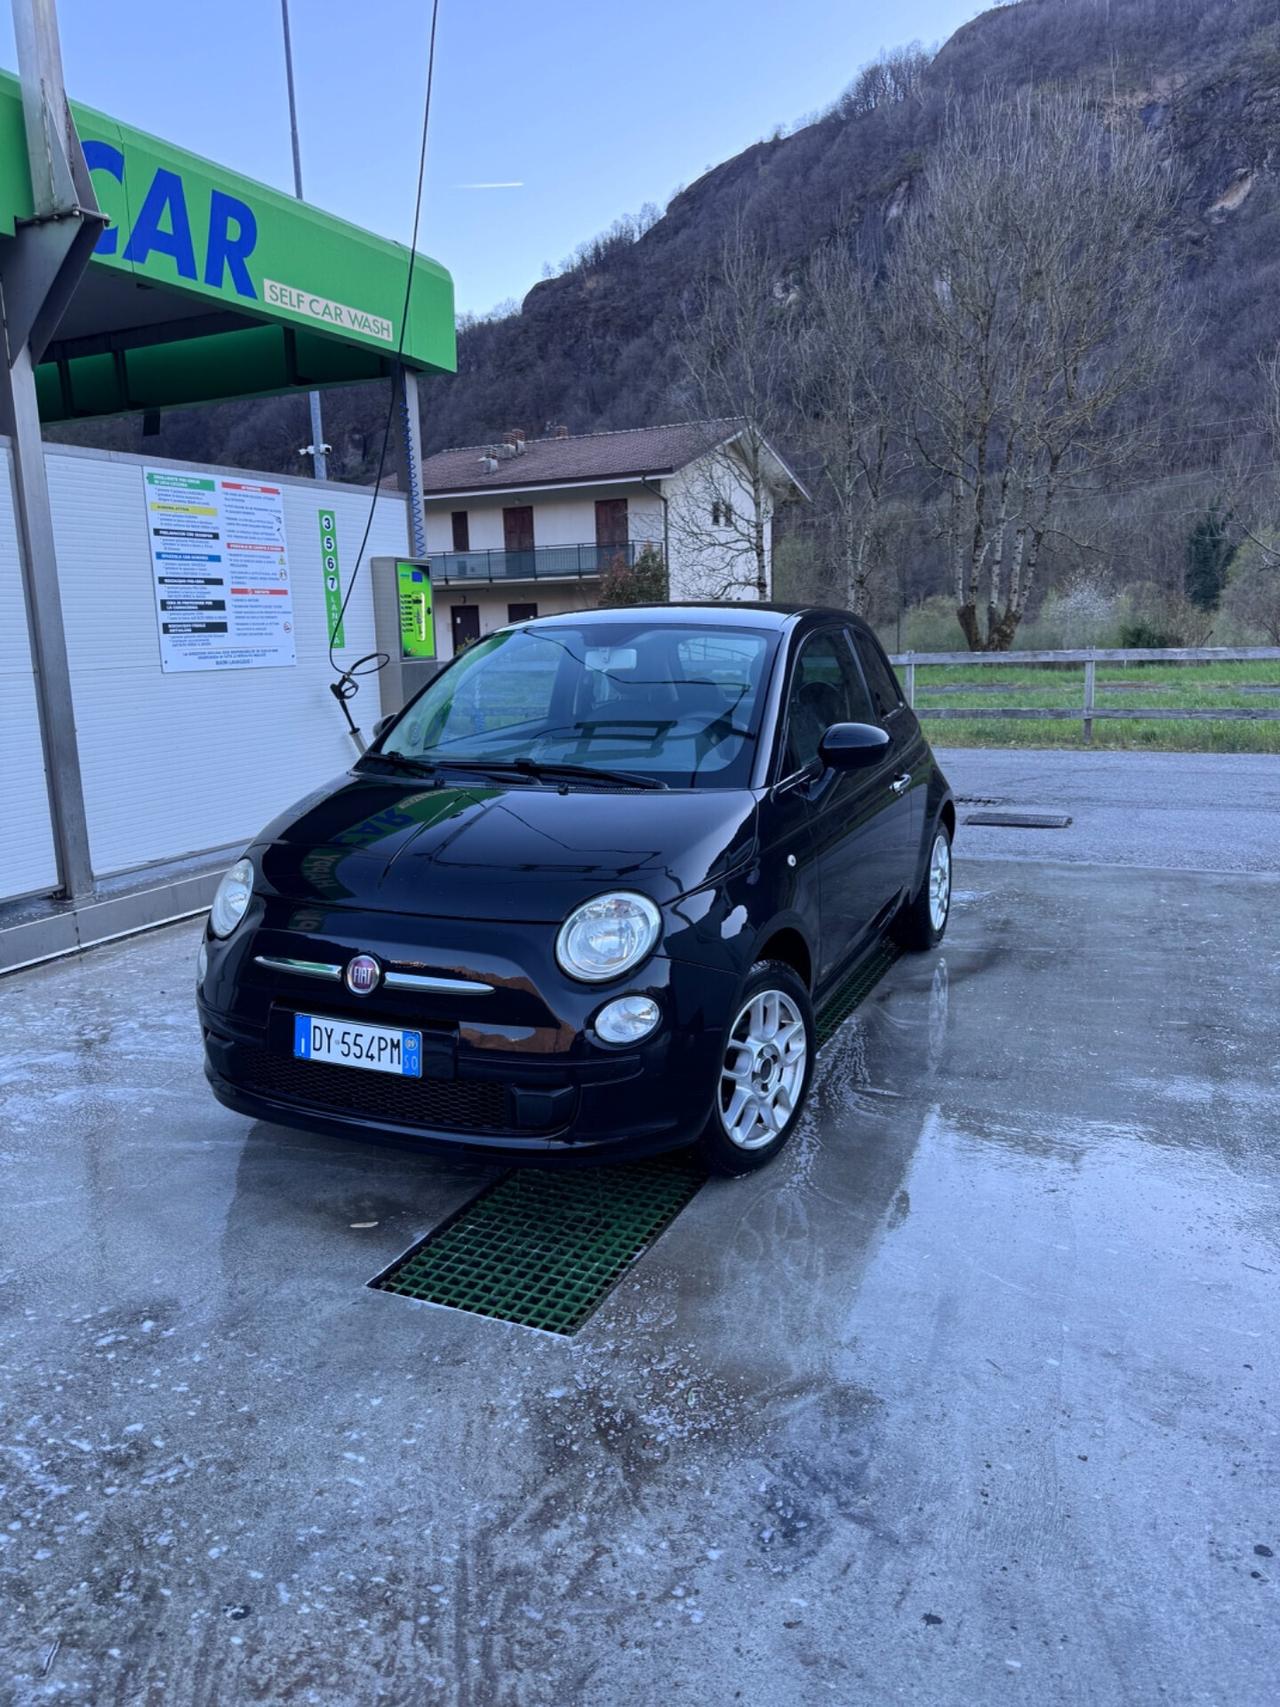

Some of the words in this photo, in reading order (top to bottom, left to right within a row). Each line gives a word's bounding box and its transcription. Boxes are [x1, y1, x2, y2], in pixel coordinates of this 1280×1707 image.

[269, 284, 305, 310] SELF
[309, 298, 344, 323] CAR
[347, 309, 391, 338] WASH
[324, 517, 331, 530] 3
[325, 537, 333, 550] 5
[327, 557, 335, 570] 6
[329, 577, 336, 589] 7
[353, 966, 374, 985] FIAT
[312, 1025, 334, 1054] DY
[340, 1031, 401, 1065] 554PM
